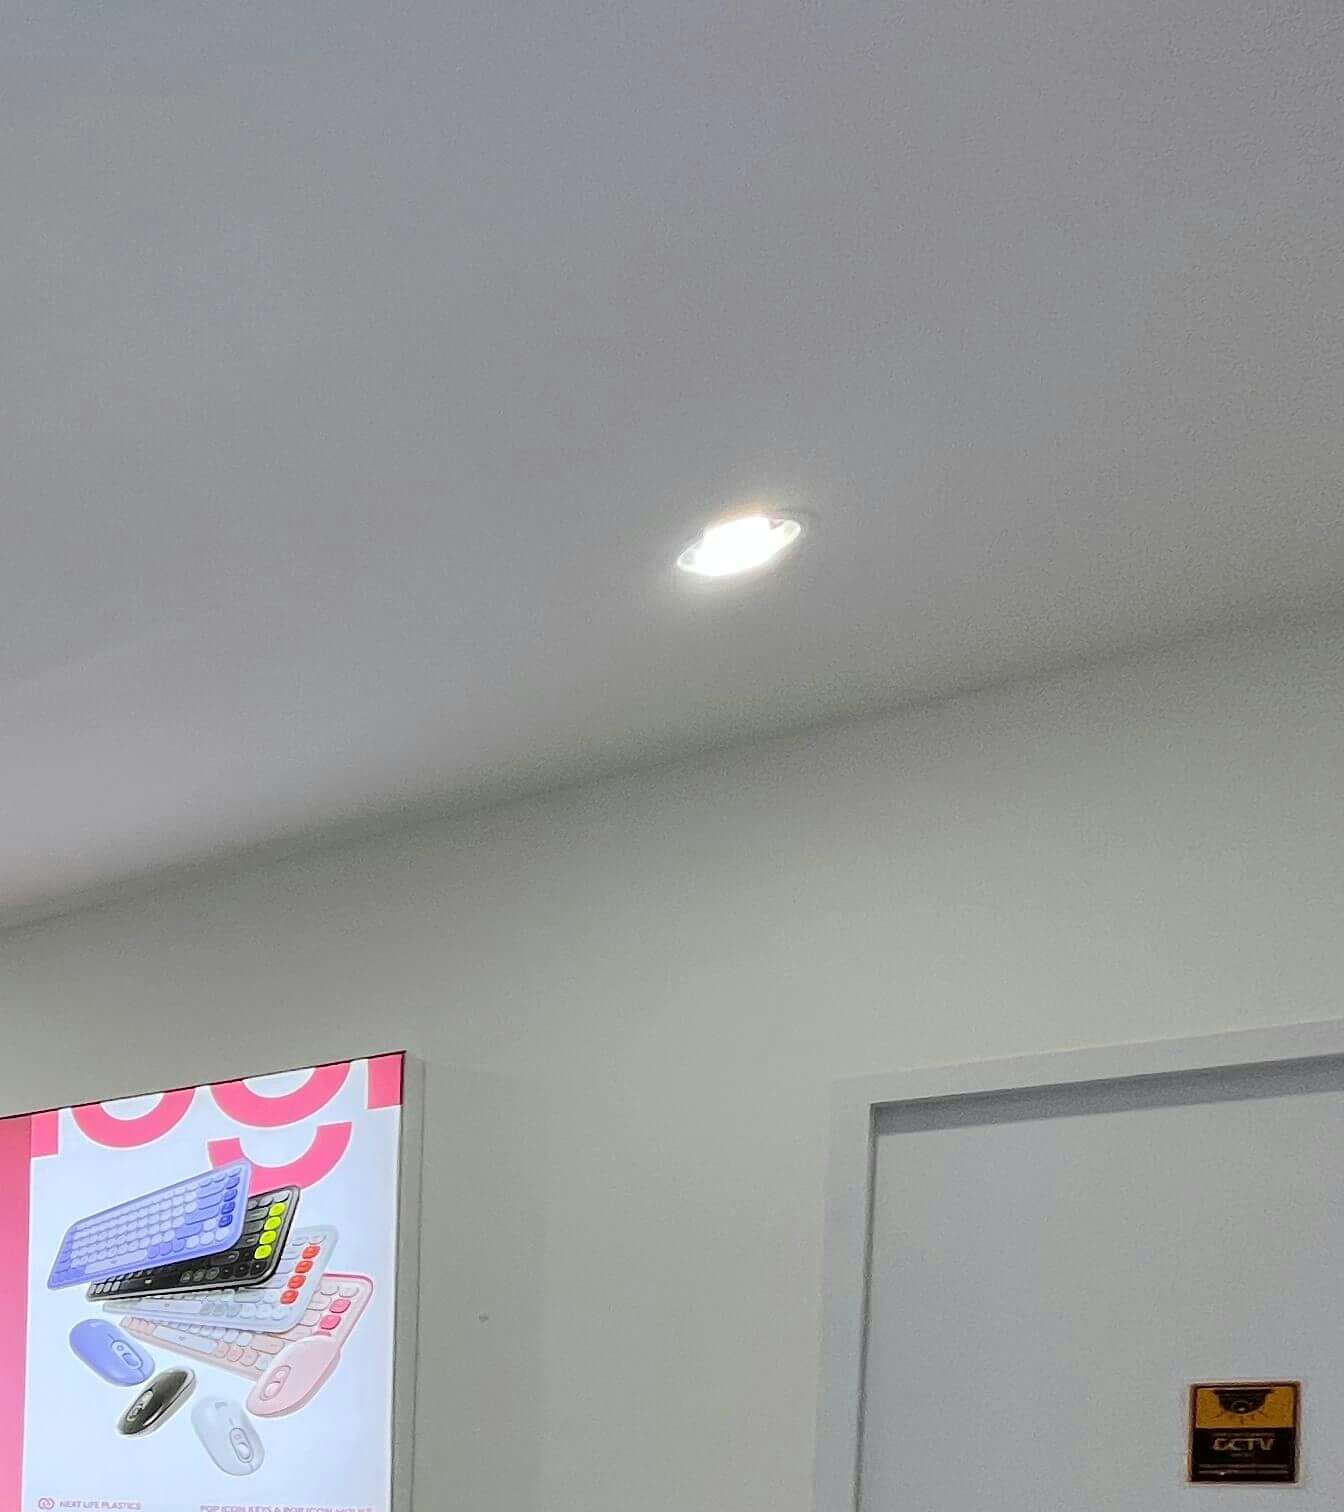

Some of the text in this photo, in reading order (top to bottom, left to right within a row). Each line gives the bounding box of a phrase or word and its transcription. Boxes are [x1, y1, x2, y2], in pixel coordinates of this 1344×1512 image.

[1212, 1437, 1277, 1452] CCTV
[100, 1501, 142, 1511] PLASTICS
[200, 1504, 220, 1512] POP
